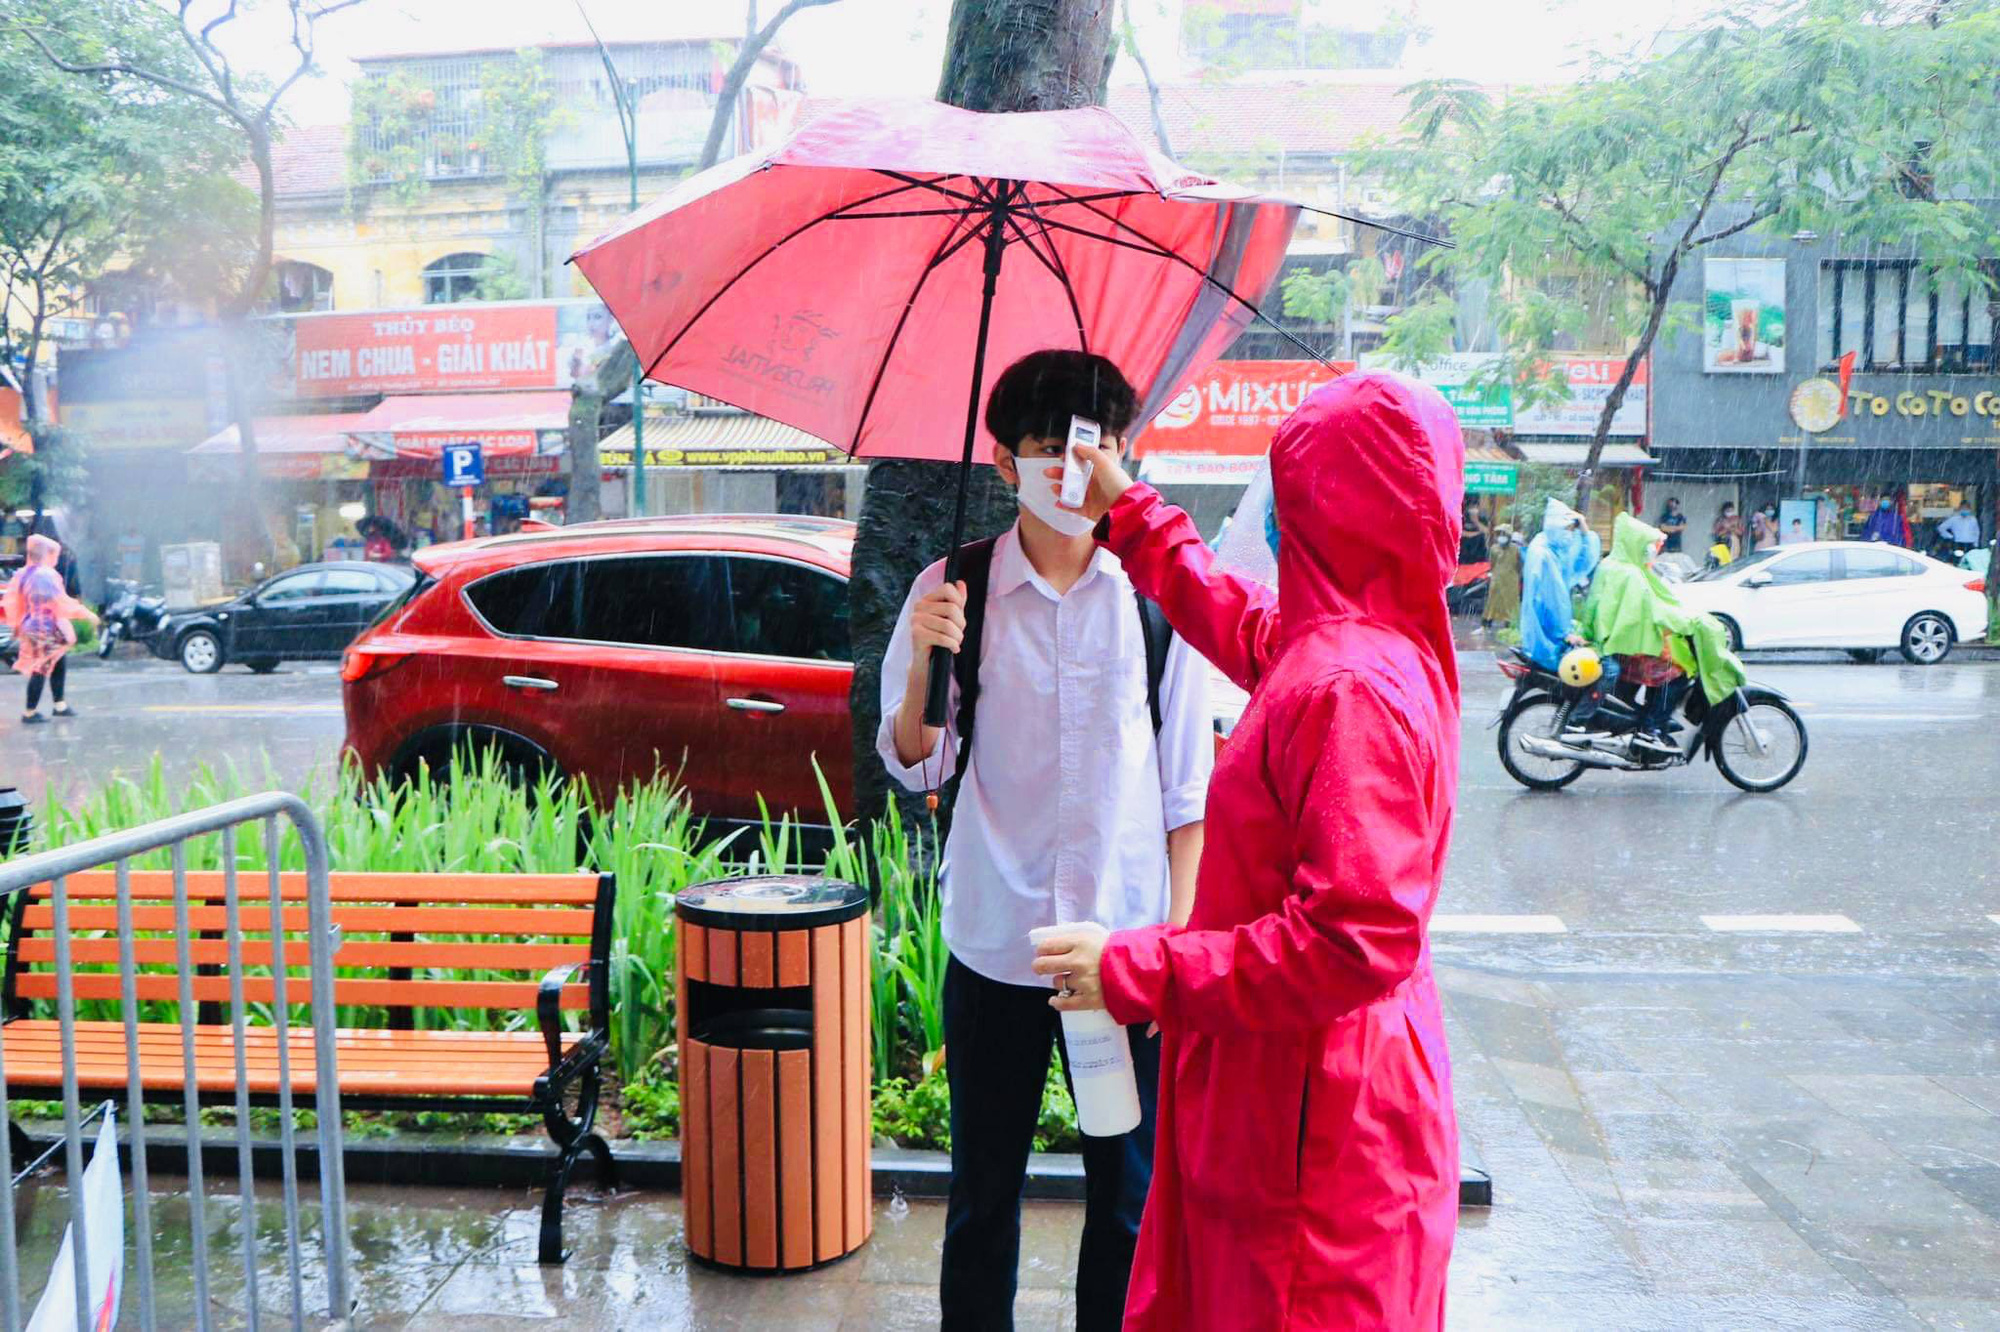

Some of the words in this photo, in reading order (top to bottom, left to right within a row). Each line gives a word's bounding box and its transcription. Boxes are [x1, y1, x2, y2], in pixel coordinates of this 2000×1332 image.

[301, 349, 350, 380] NEM
[357, 344, 416, 377] CHUA
[437, 335, 483, 374] GIẢI
[491, 333, 549, 372] KHÁT
[452, 450, 473, 475] P
